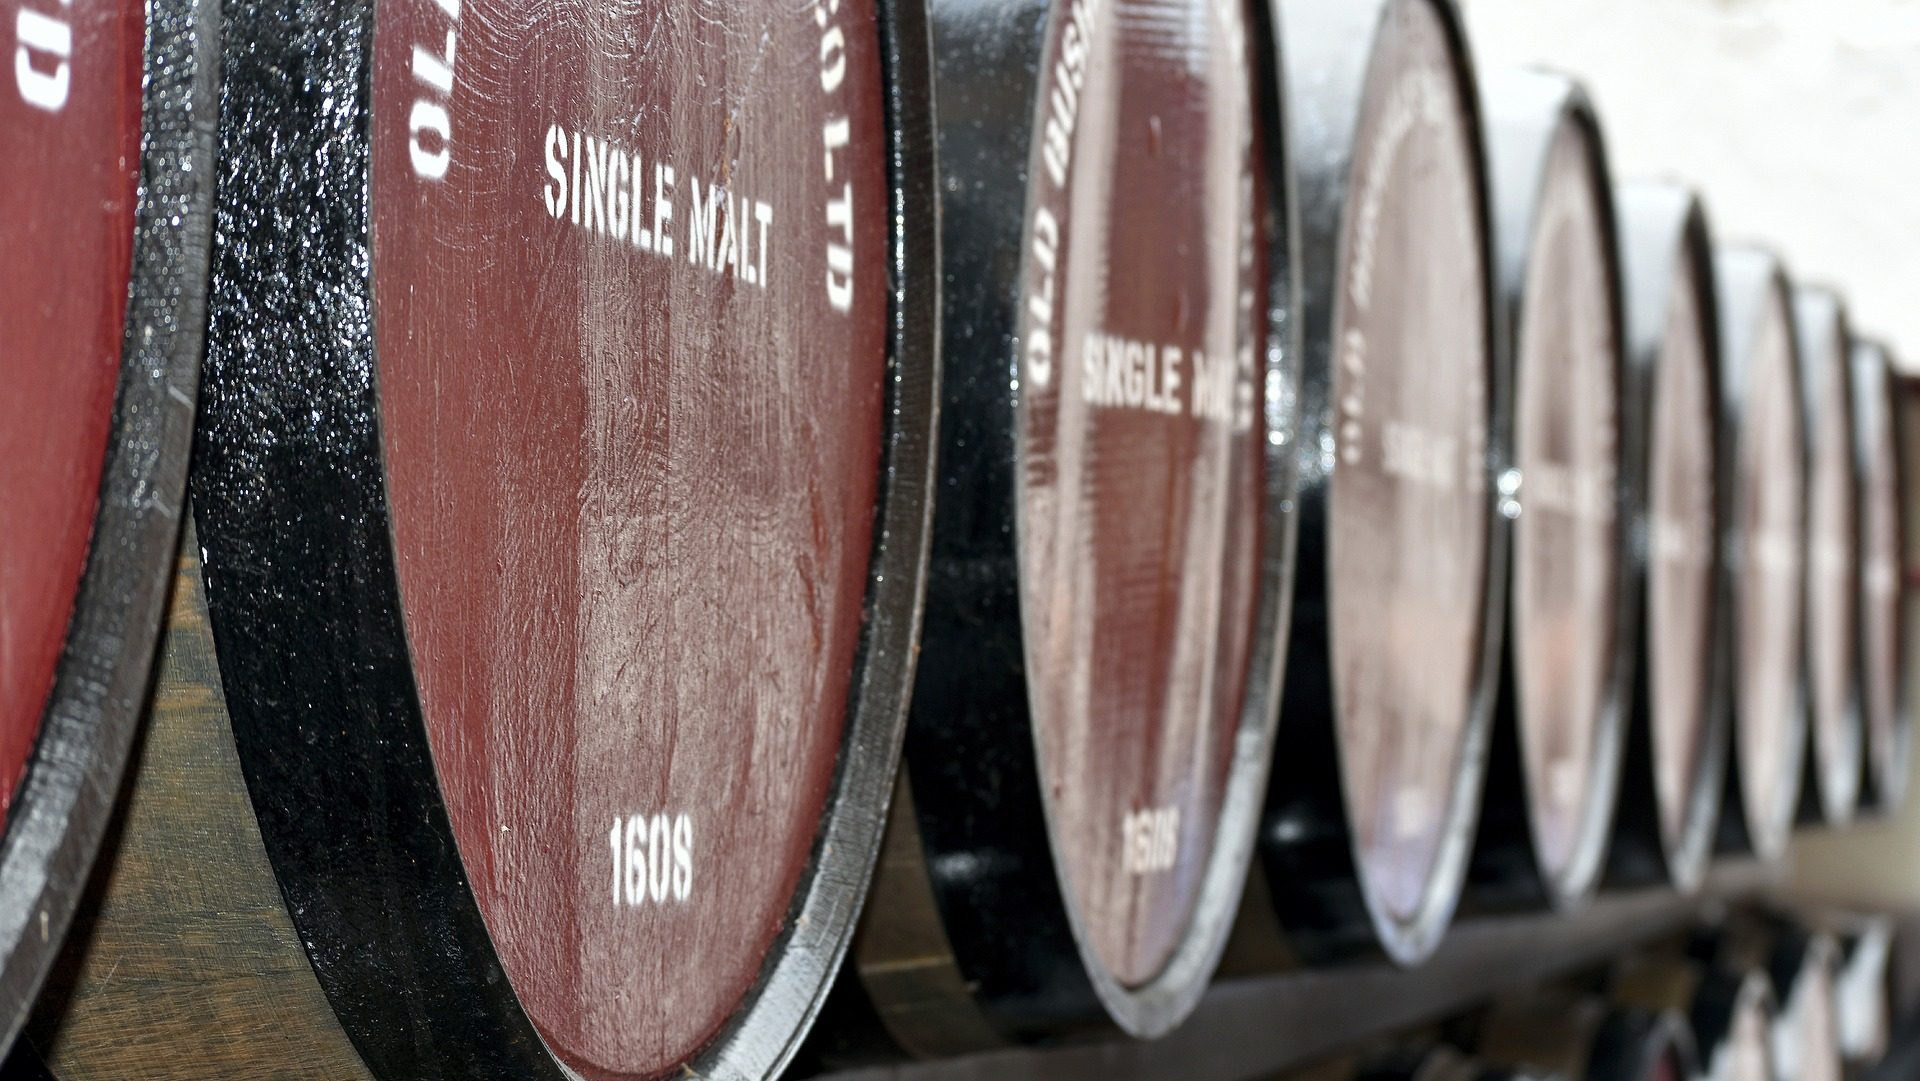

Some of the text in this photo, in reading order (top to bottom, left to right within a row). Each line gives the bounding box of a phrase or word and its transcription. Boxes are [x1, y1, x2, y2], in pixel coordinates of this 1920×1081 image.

[15, 0, 71, 110] D
[544, 123, 773, 288] SINGLE MALT
[823, 117, 853, 312] LTD
[1027, 206, 1059, 390] OLD
[1082, 333, 1183, 415] SINGLE
[610, 811, 693, 906] 1608
